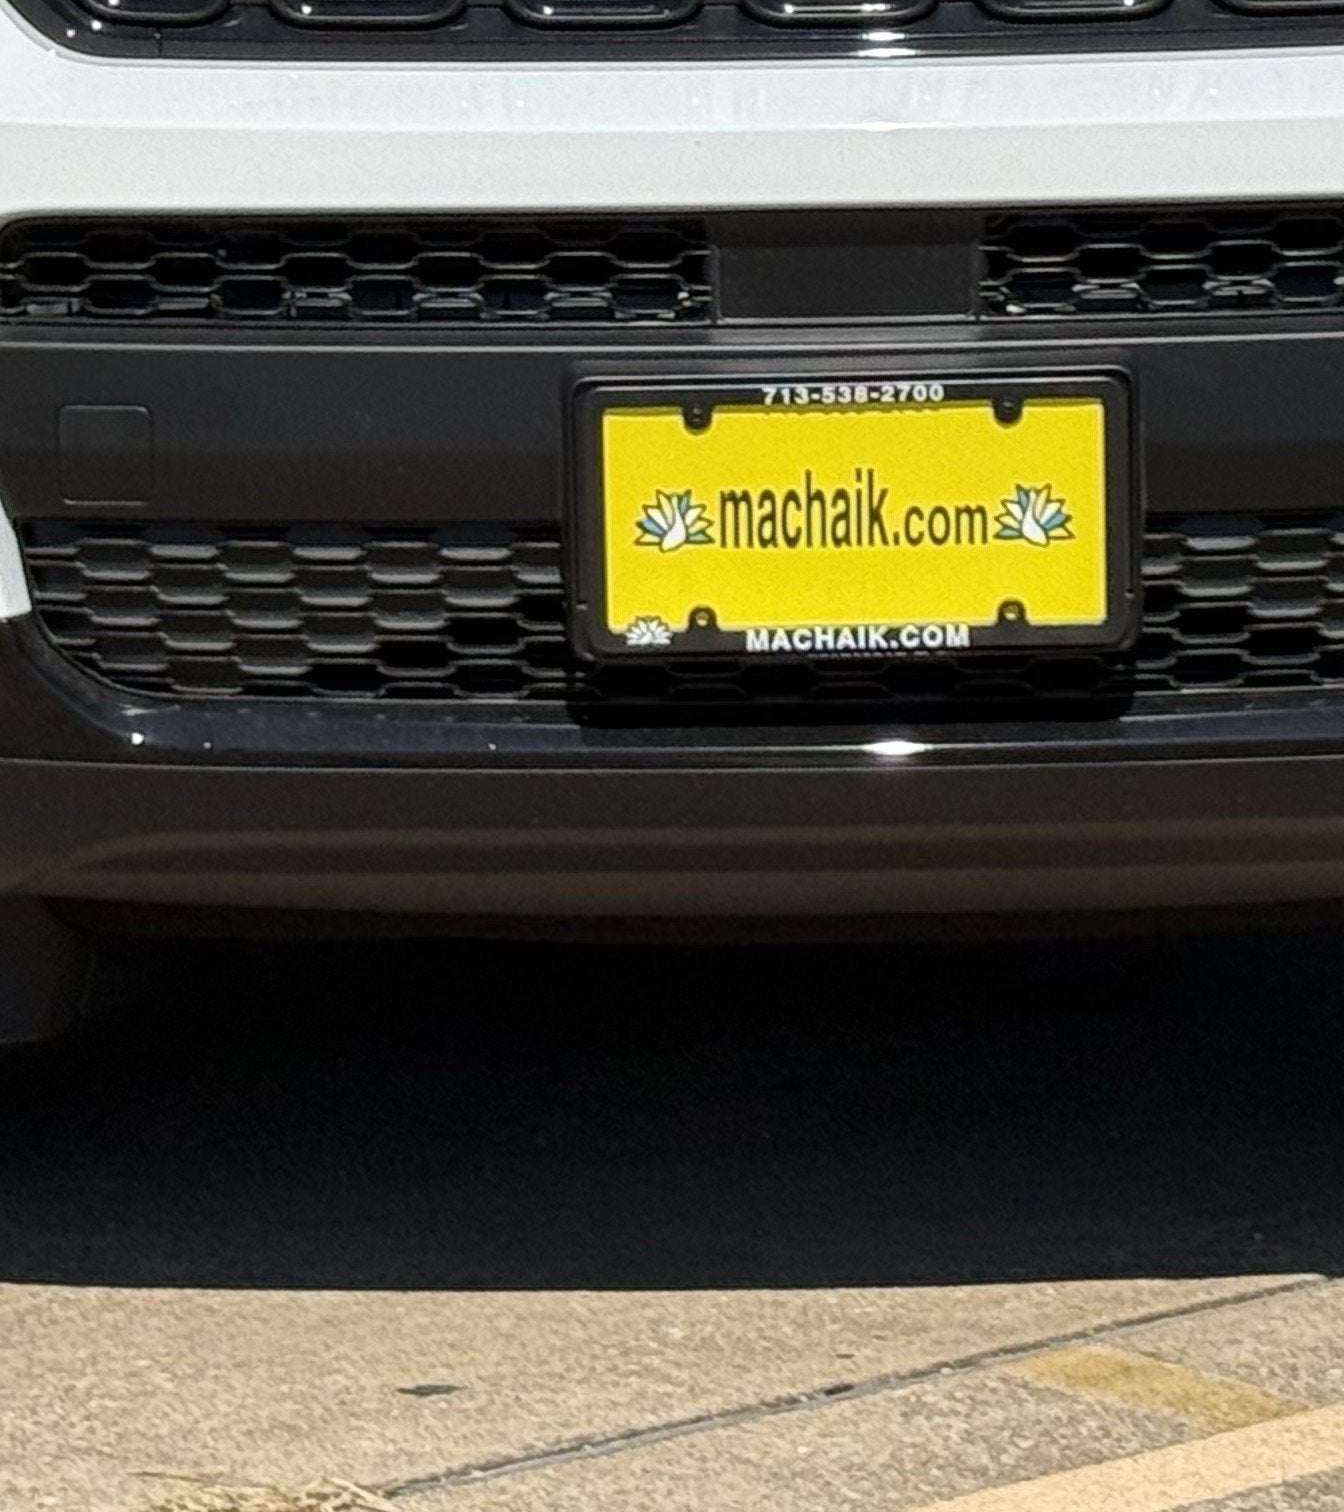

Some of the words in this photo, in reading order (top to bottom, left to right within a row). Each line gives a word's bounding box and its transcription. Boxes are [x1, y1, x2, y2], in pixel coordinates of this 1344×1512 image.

[762, 384, 944, 405] 713-538-2700
[719, 468, 988, 549] machaik.com
[746, 624, 970, 651] MACHAIK.COM
